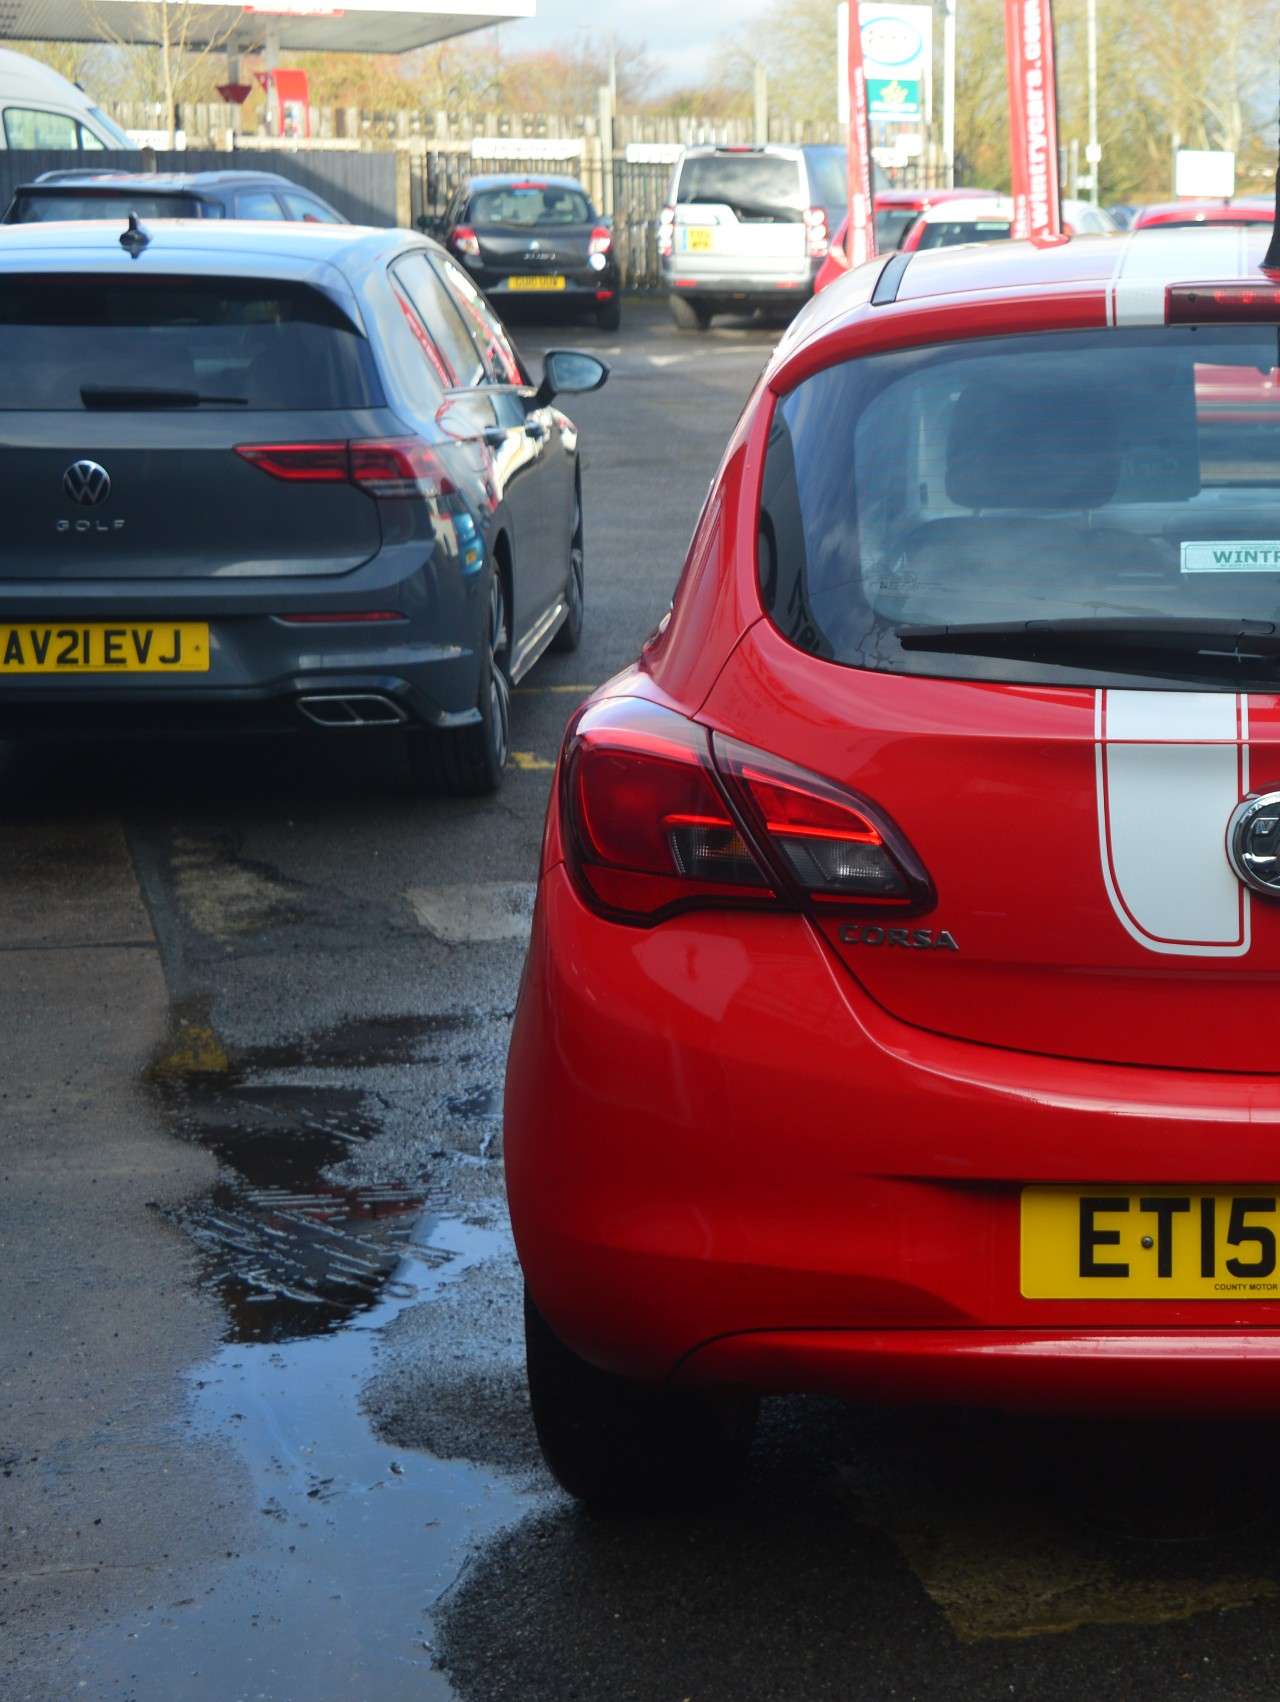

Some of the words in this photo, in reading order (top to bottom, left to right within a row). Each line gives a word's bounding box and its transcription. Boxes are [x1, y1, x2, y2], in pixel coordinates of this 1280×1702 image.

[56, 519, 125, 532] GOLF
[3, 629, 91, 664] AV21
[104, 629, 181, 664] EVJ
[838, 923, 960, 951] CORSA
[1079, 1196, 1277, 1278] ET15
